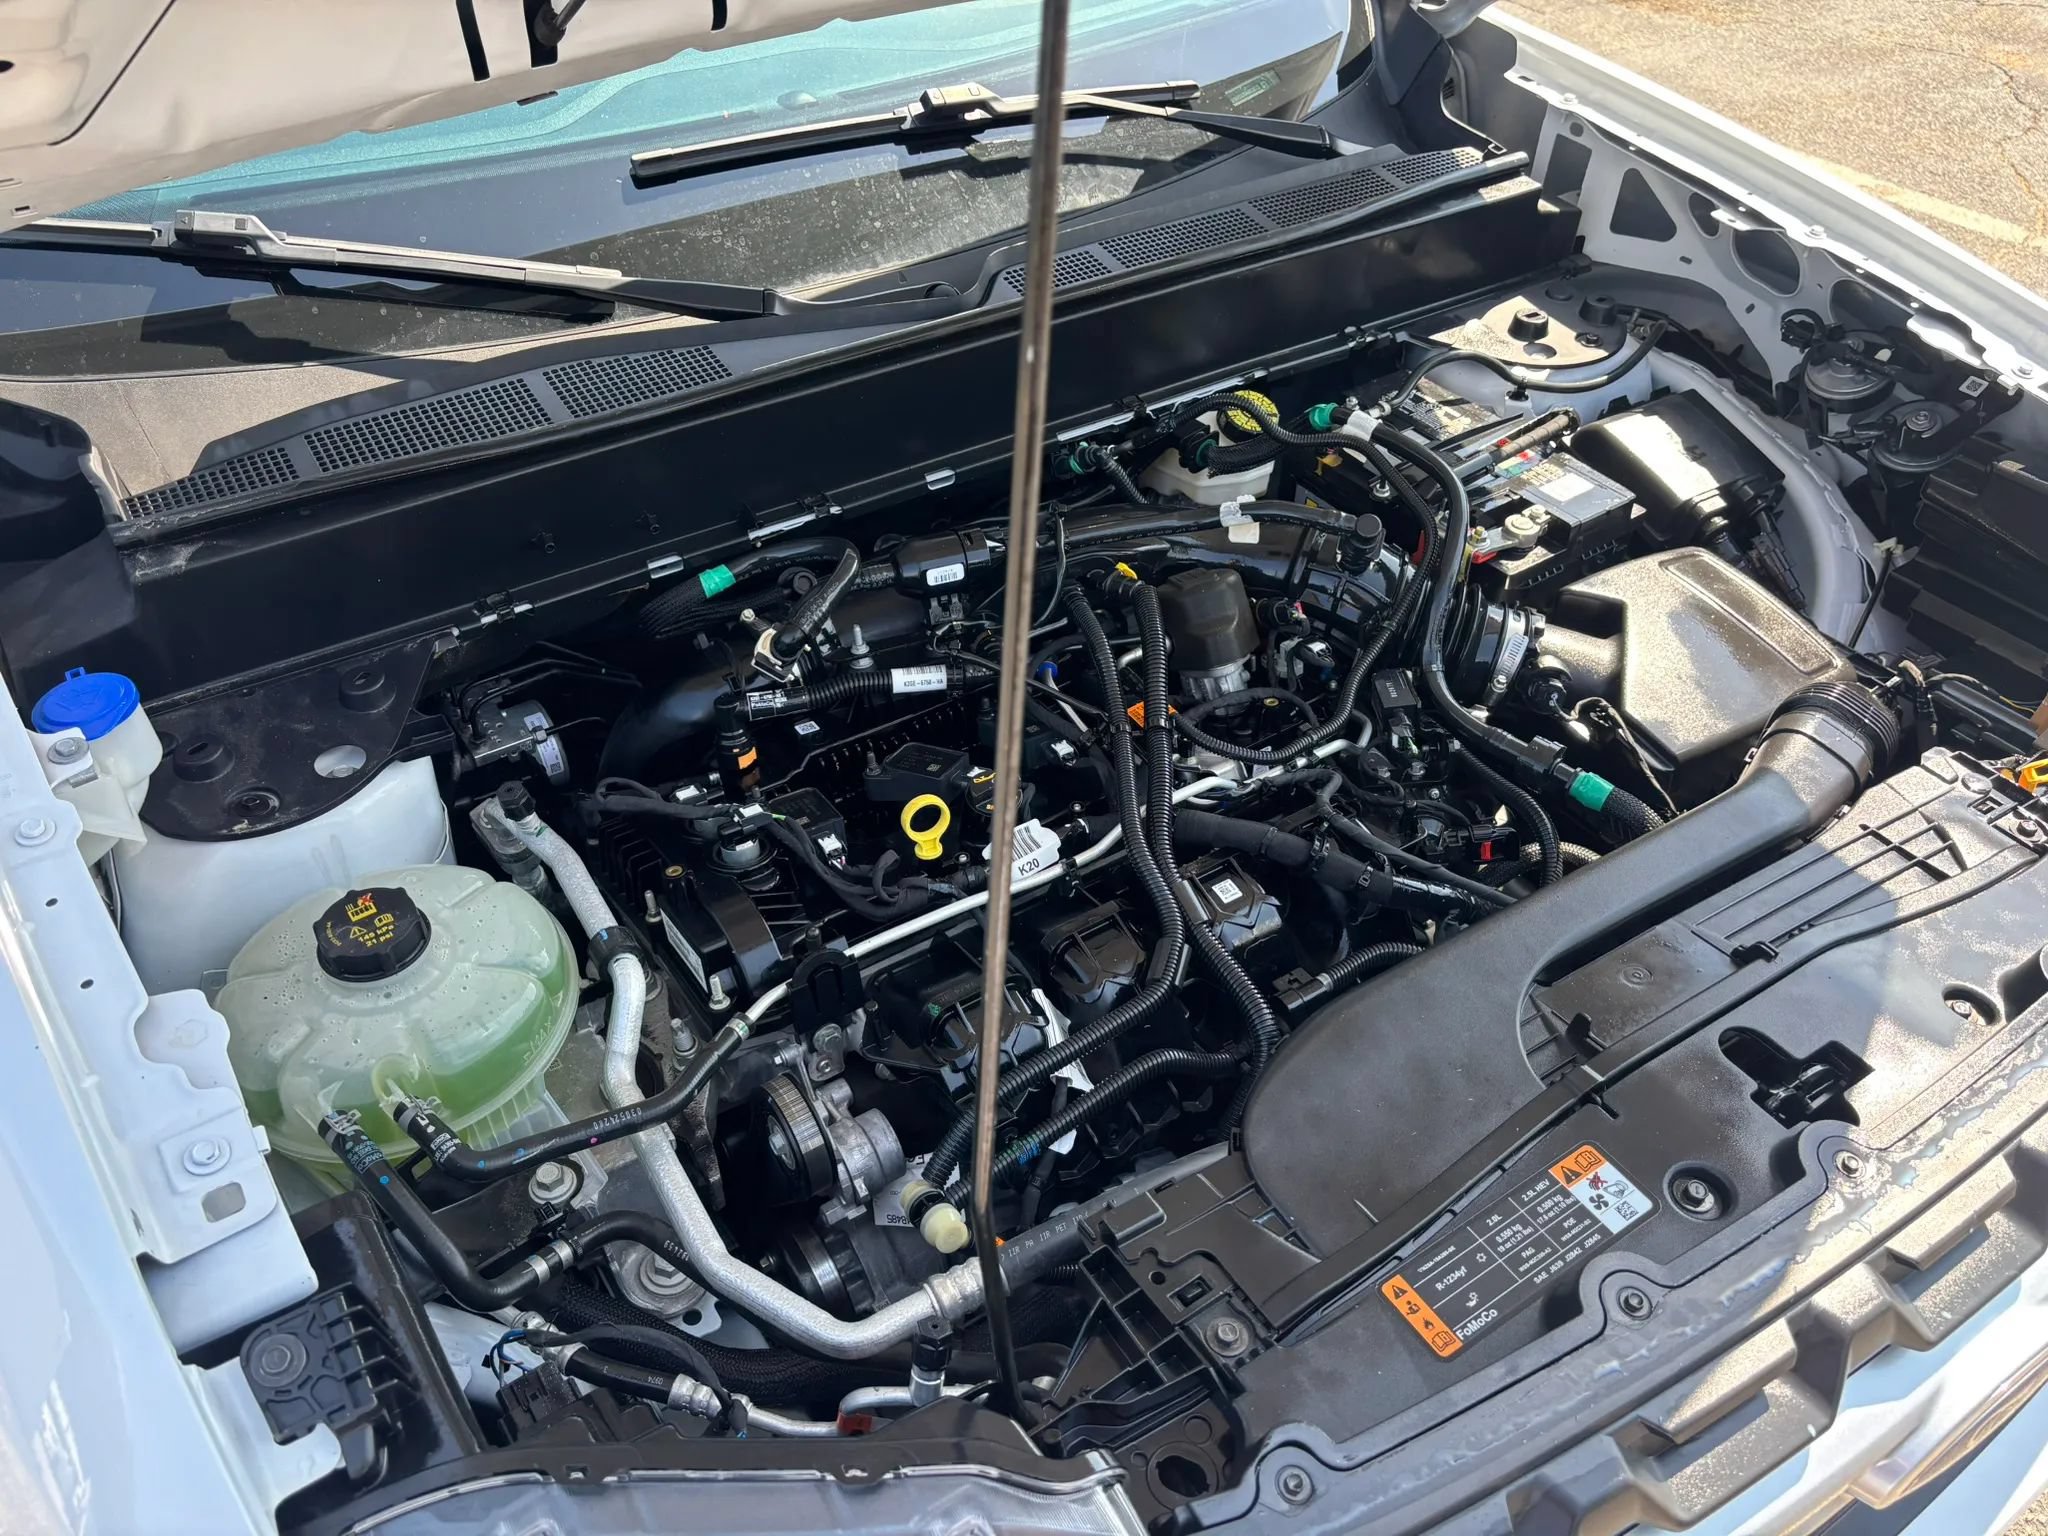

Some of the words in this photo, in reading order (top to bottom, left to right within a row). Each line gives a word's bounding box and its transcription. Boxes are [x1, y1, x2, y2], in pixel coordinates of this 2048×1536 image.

[1018, 858, 1040, 876] K20
[1522, 1190, 1536, 1202] 2.5L
[1535, 1179, 1550, 1192] HEV
[1537, 1199, 1554, 1213] 0.500
[1552, 1192, 1563, 1203] kg
[1486, 1214, 1502, 1226] 2.0L
[1546, 1209, 1555, 1218] oz
[1562, 1216, 1576, 1229] POE
[1023, 1238, 1035, 1249] PA
[1054, 1221, 1068, 1234] PET
[1495, 1229, 1513, 1243] 0.550
[1510, 1221, 1522, 1233] kg
[1503, 1240, 1512, 1248] oz
[1520, 1245, 1535, 1258] PAG
[1435, 1266, 1467, 1291] R-1234yf
[1533, 1271, 1549, 1284] SAE
[1549, 1259, 1564, 1272] J639
[1456, 1308, 1498, 1341] FoMoCo
